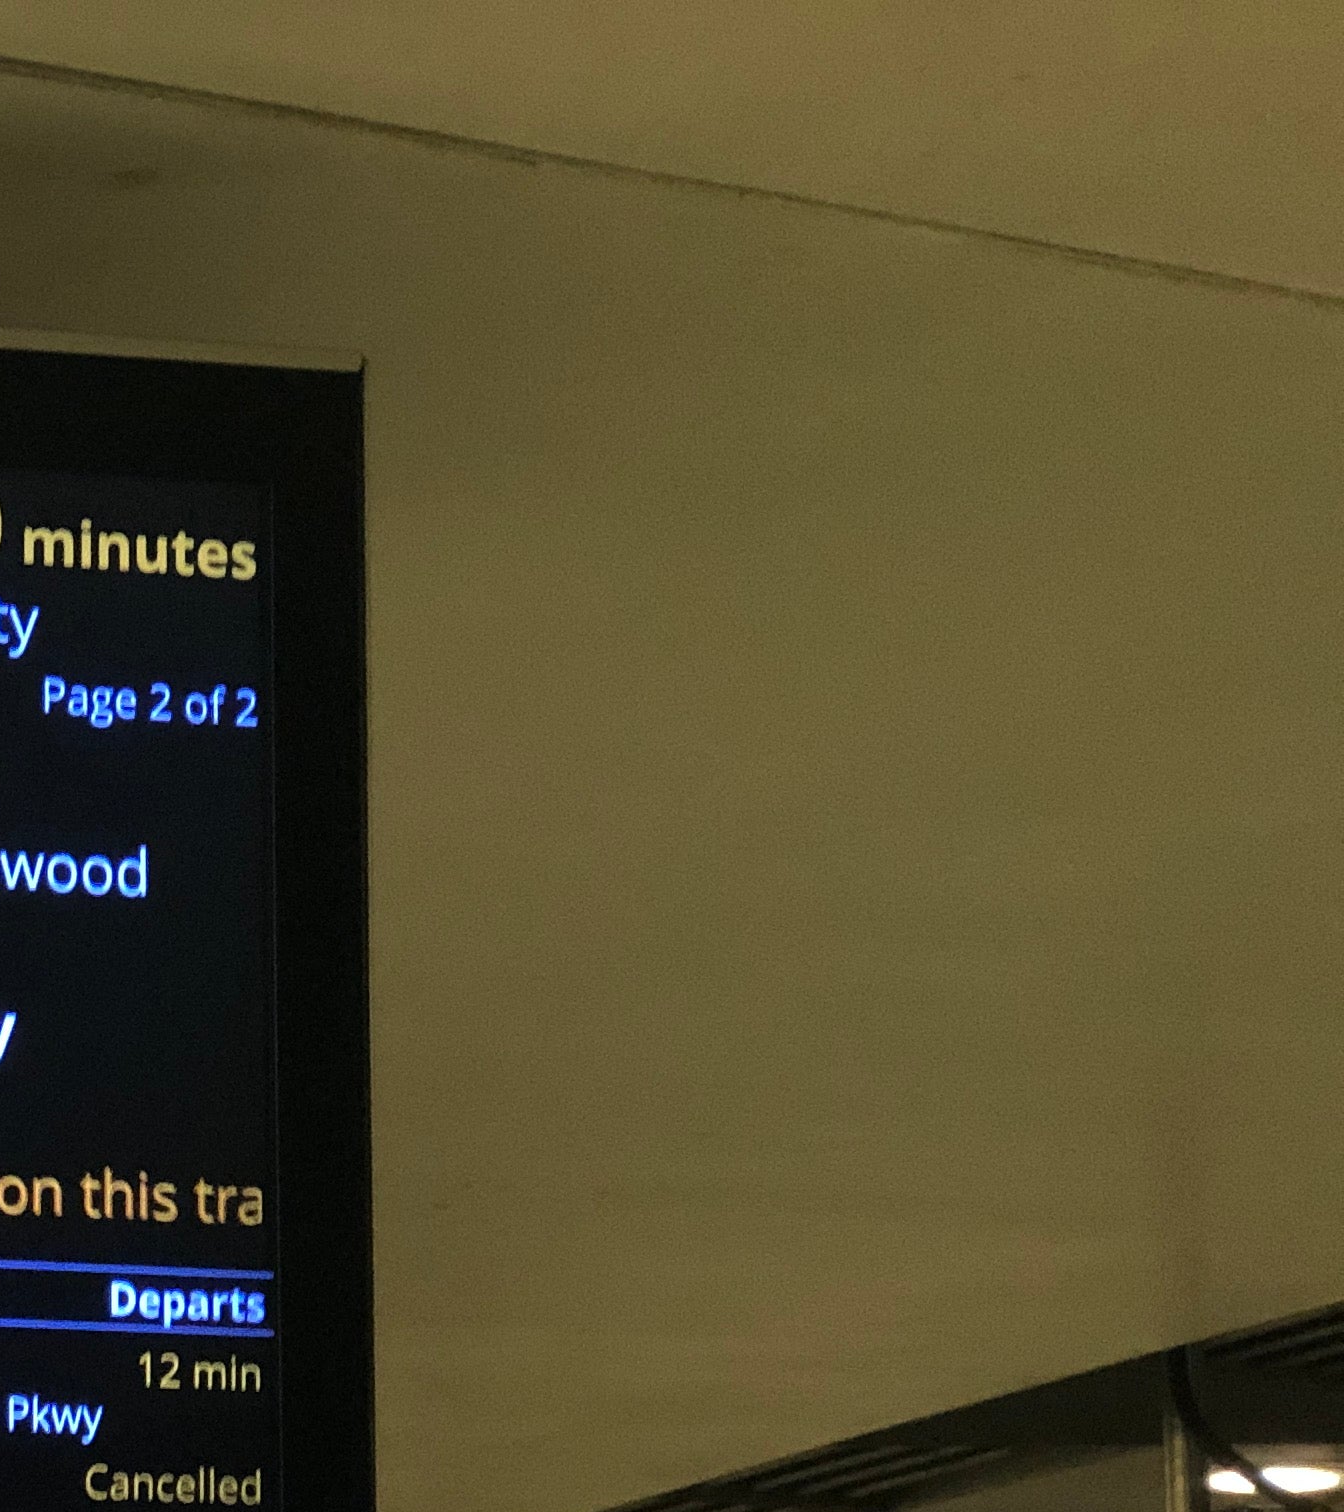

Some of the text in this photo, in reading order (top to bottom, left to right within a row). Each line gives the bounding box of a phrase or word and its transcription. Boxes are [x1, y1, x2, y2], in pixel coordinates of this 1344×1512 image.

[23, 518, 257, 581] minutes
[41, 674, 259, 729] Page 2 of 2
[80, 1166, 178, 1223] this
[109, 1279, 265, 1330] Departs
[139, 1351, 261, 1392] 12 min
[6, 1393, 104, 1446] Pkwy
[85, 1463, 262, 1506] Cancelled
